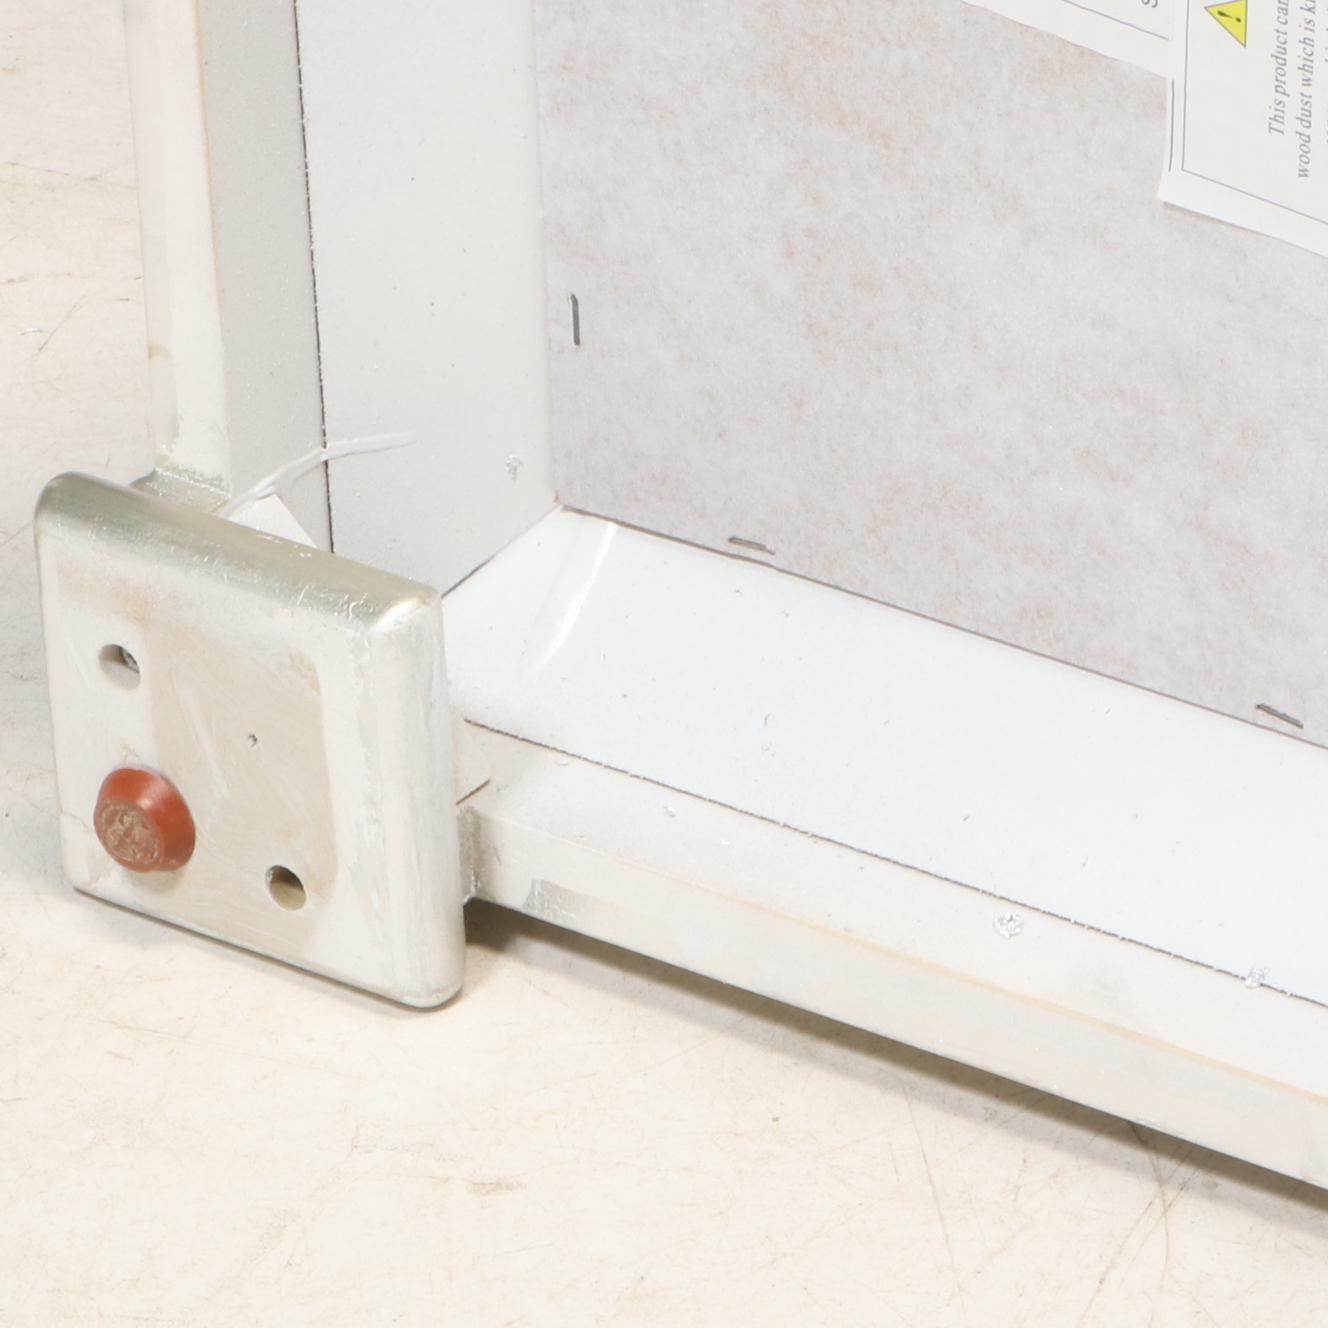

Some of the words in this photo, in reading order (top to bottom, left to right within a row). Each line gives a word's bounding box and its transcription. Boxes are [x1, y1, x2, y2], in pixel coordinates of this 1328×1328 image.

[1300, 18, 1316, 33] is
[1271, 29, 1290, 97] product
[1298, 38, 1315, 88] which
[1268, 99, 1286, 136] This
[1296, 92, 1312, 129] dust
[1295, 132, 1311, 178] wood
